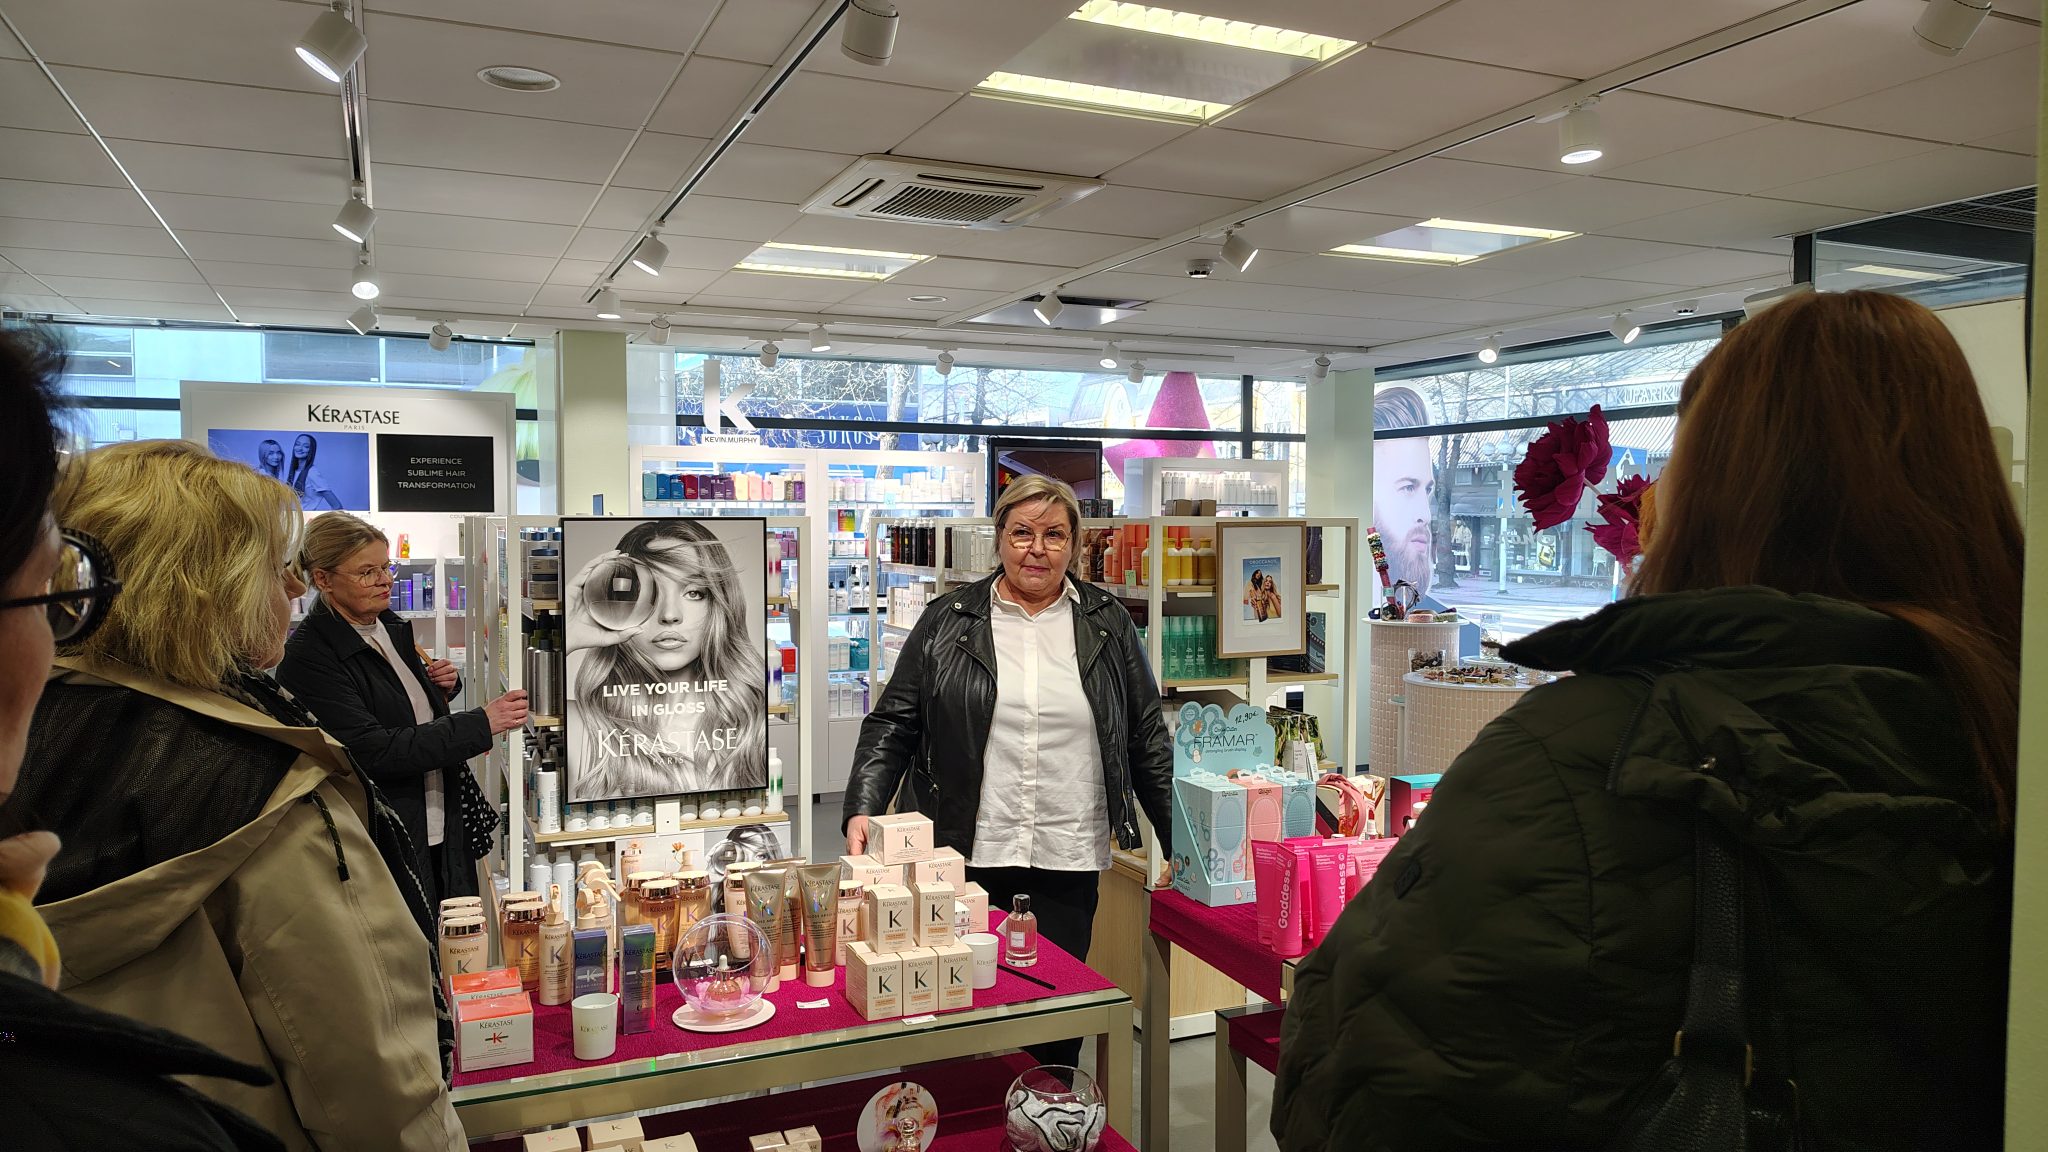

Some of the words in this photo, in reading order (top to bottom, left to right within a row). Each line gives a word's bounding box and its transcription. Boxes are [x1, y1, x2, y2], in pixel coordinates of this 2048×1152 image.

[308, 404, 400, 424] KÉRASTASE
[410, 457, 462, 465] EXPERIENCE
[407, 469, 444, 477] SUBLIME
[397, 481, 476, 489] TRANSFORMATION
[603, 684, 641, 697] LIVE
[644, 682, 690, 695] YOUR
[694, 680, 728, 693] LIFE
[632, 705, 648, 717] IN
[653, 702, 706, 716] GLOSS
[598, 728, 738, 759] KÉRASTASE
[652, 757, 684, 765] PARIS
[904, 835, 914, 848] K
[1338, 864, 1346, 911] oddess
[1278, 869, 1291, 929] Goddess
[889, 909, 903, 928] K
[931, 904, 944, 922] K
[842, 918, 855, 935] K
[449, 946, 479, 955] KÉRASTASE
[520, 940, 533, 958] K
[550, 945, 564, 964] K
[908, 960, 933, 968] KÉRASTASE
[943, 956, 968, 964] KÉRASTASE
[872, 965, 897, 973] KÉRASTASE
[950, 965, 963, 984] K
[878, 973, 892, 994] K
[915, 969, 928, 989] K
[479, 1019, 513, 1029] KÉRASTASE
